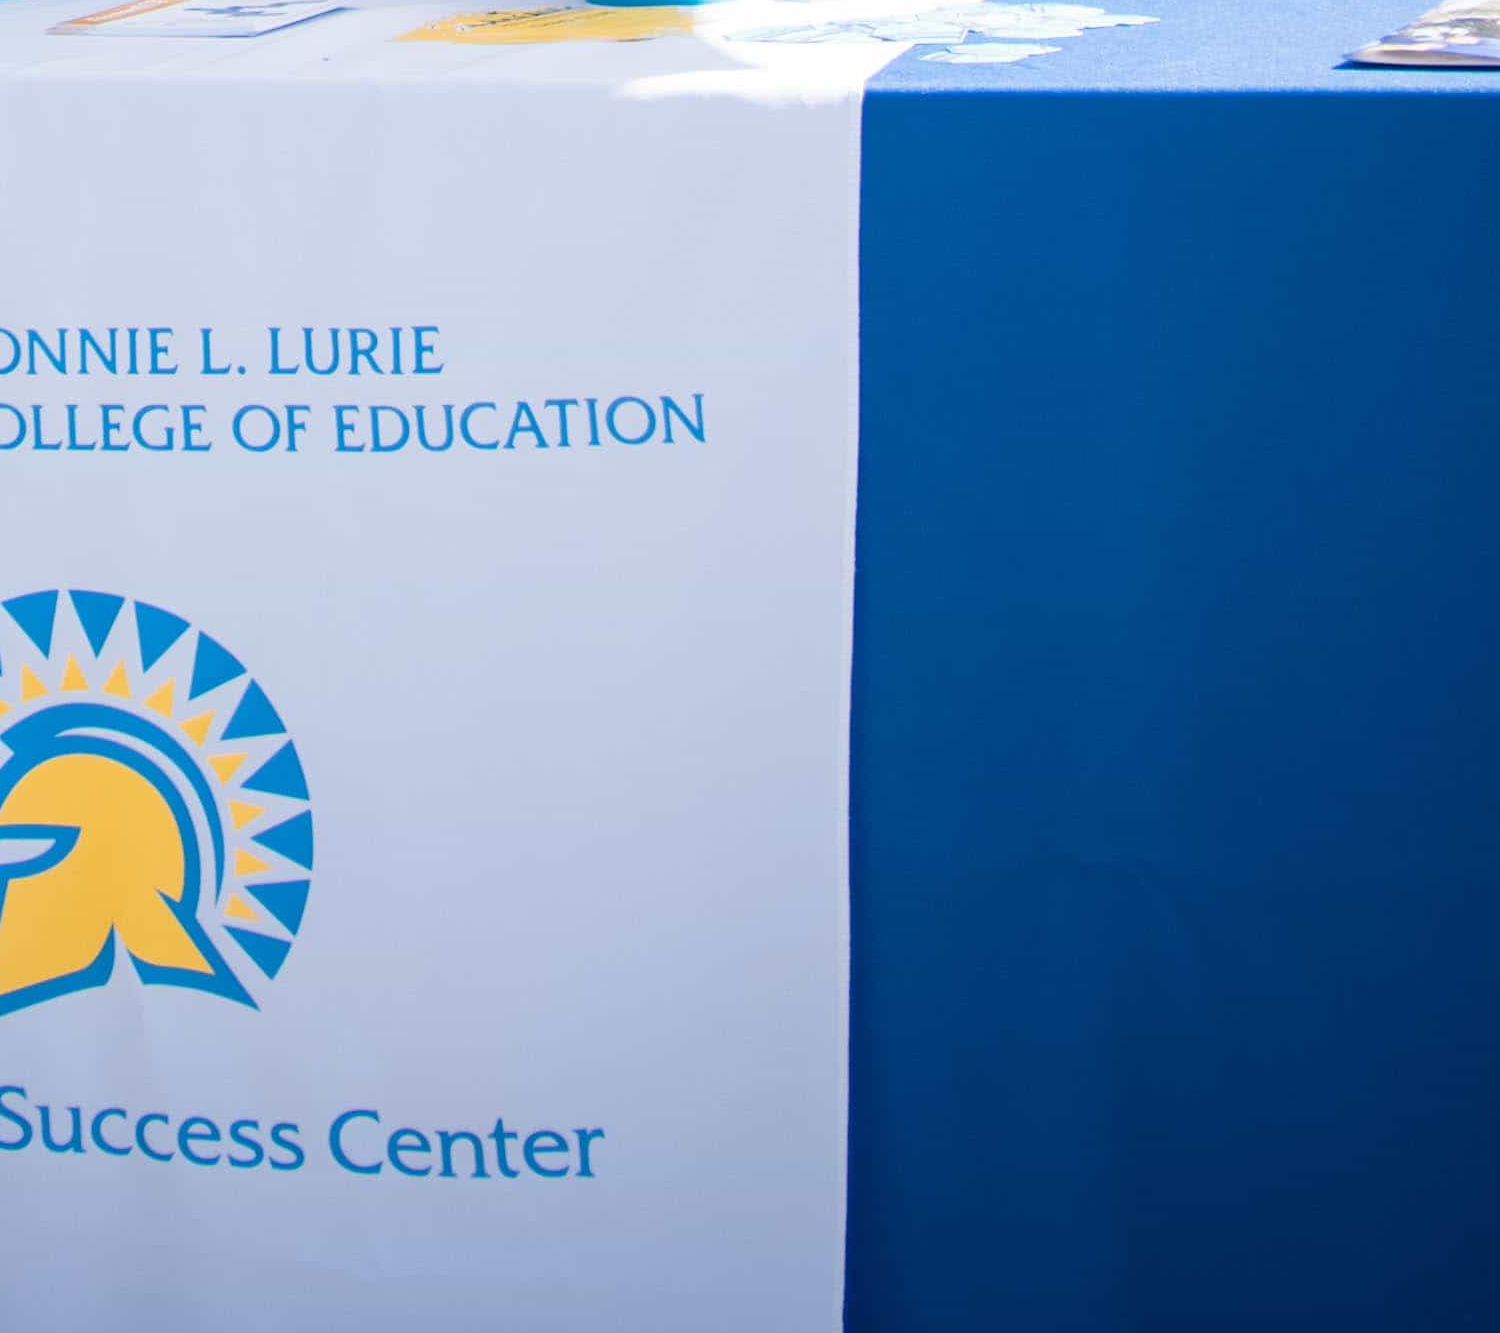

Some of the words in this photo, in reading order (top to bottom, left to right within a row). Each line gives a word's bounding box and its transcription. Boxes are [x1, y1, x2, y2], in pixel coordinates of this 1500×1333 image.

[199, 326, 248, 378] L.
[266, 325, 444, 378] LURIE
[231, 400, 313, 453] OF
[333, 392, 708, 455] EDUCATION
[326, 1106, 606, 1181] Center
